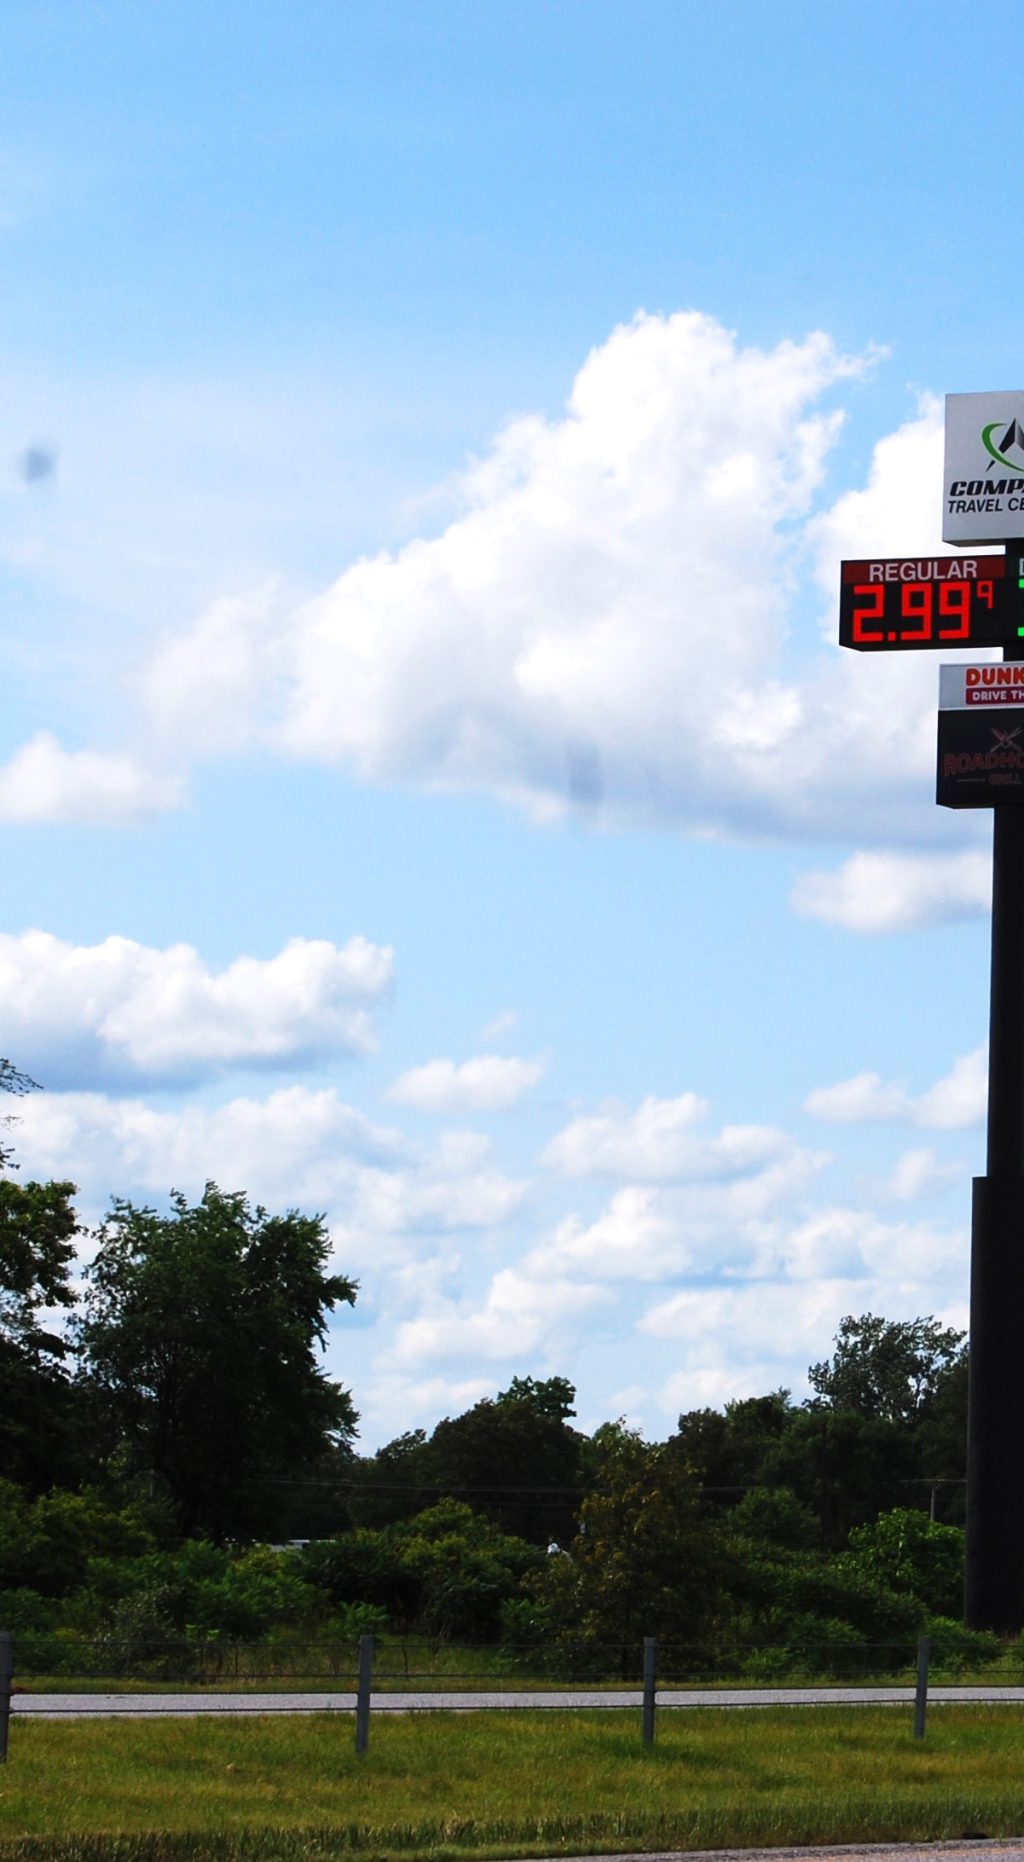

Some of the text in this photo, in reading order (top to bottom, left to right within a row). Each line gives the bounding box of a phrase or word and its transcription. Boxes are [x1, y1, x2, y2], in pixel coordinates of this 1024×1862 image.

[948, 499, 1003, 514] TRAVEL
[869, 560, 977, 582] REGULAR
[972, 690, 1007, 701] DRIVE
